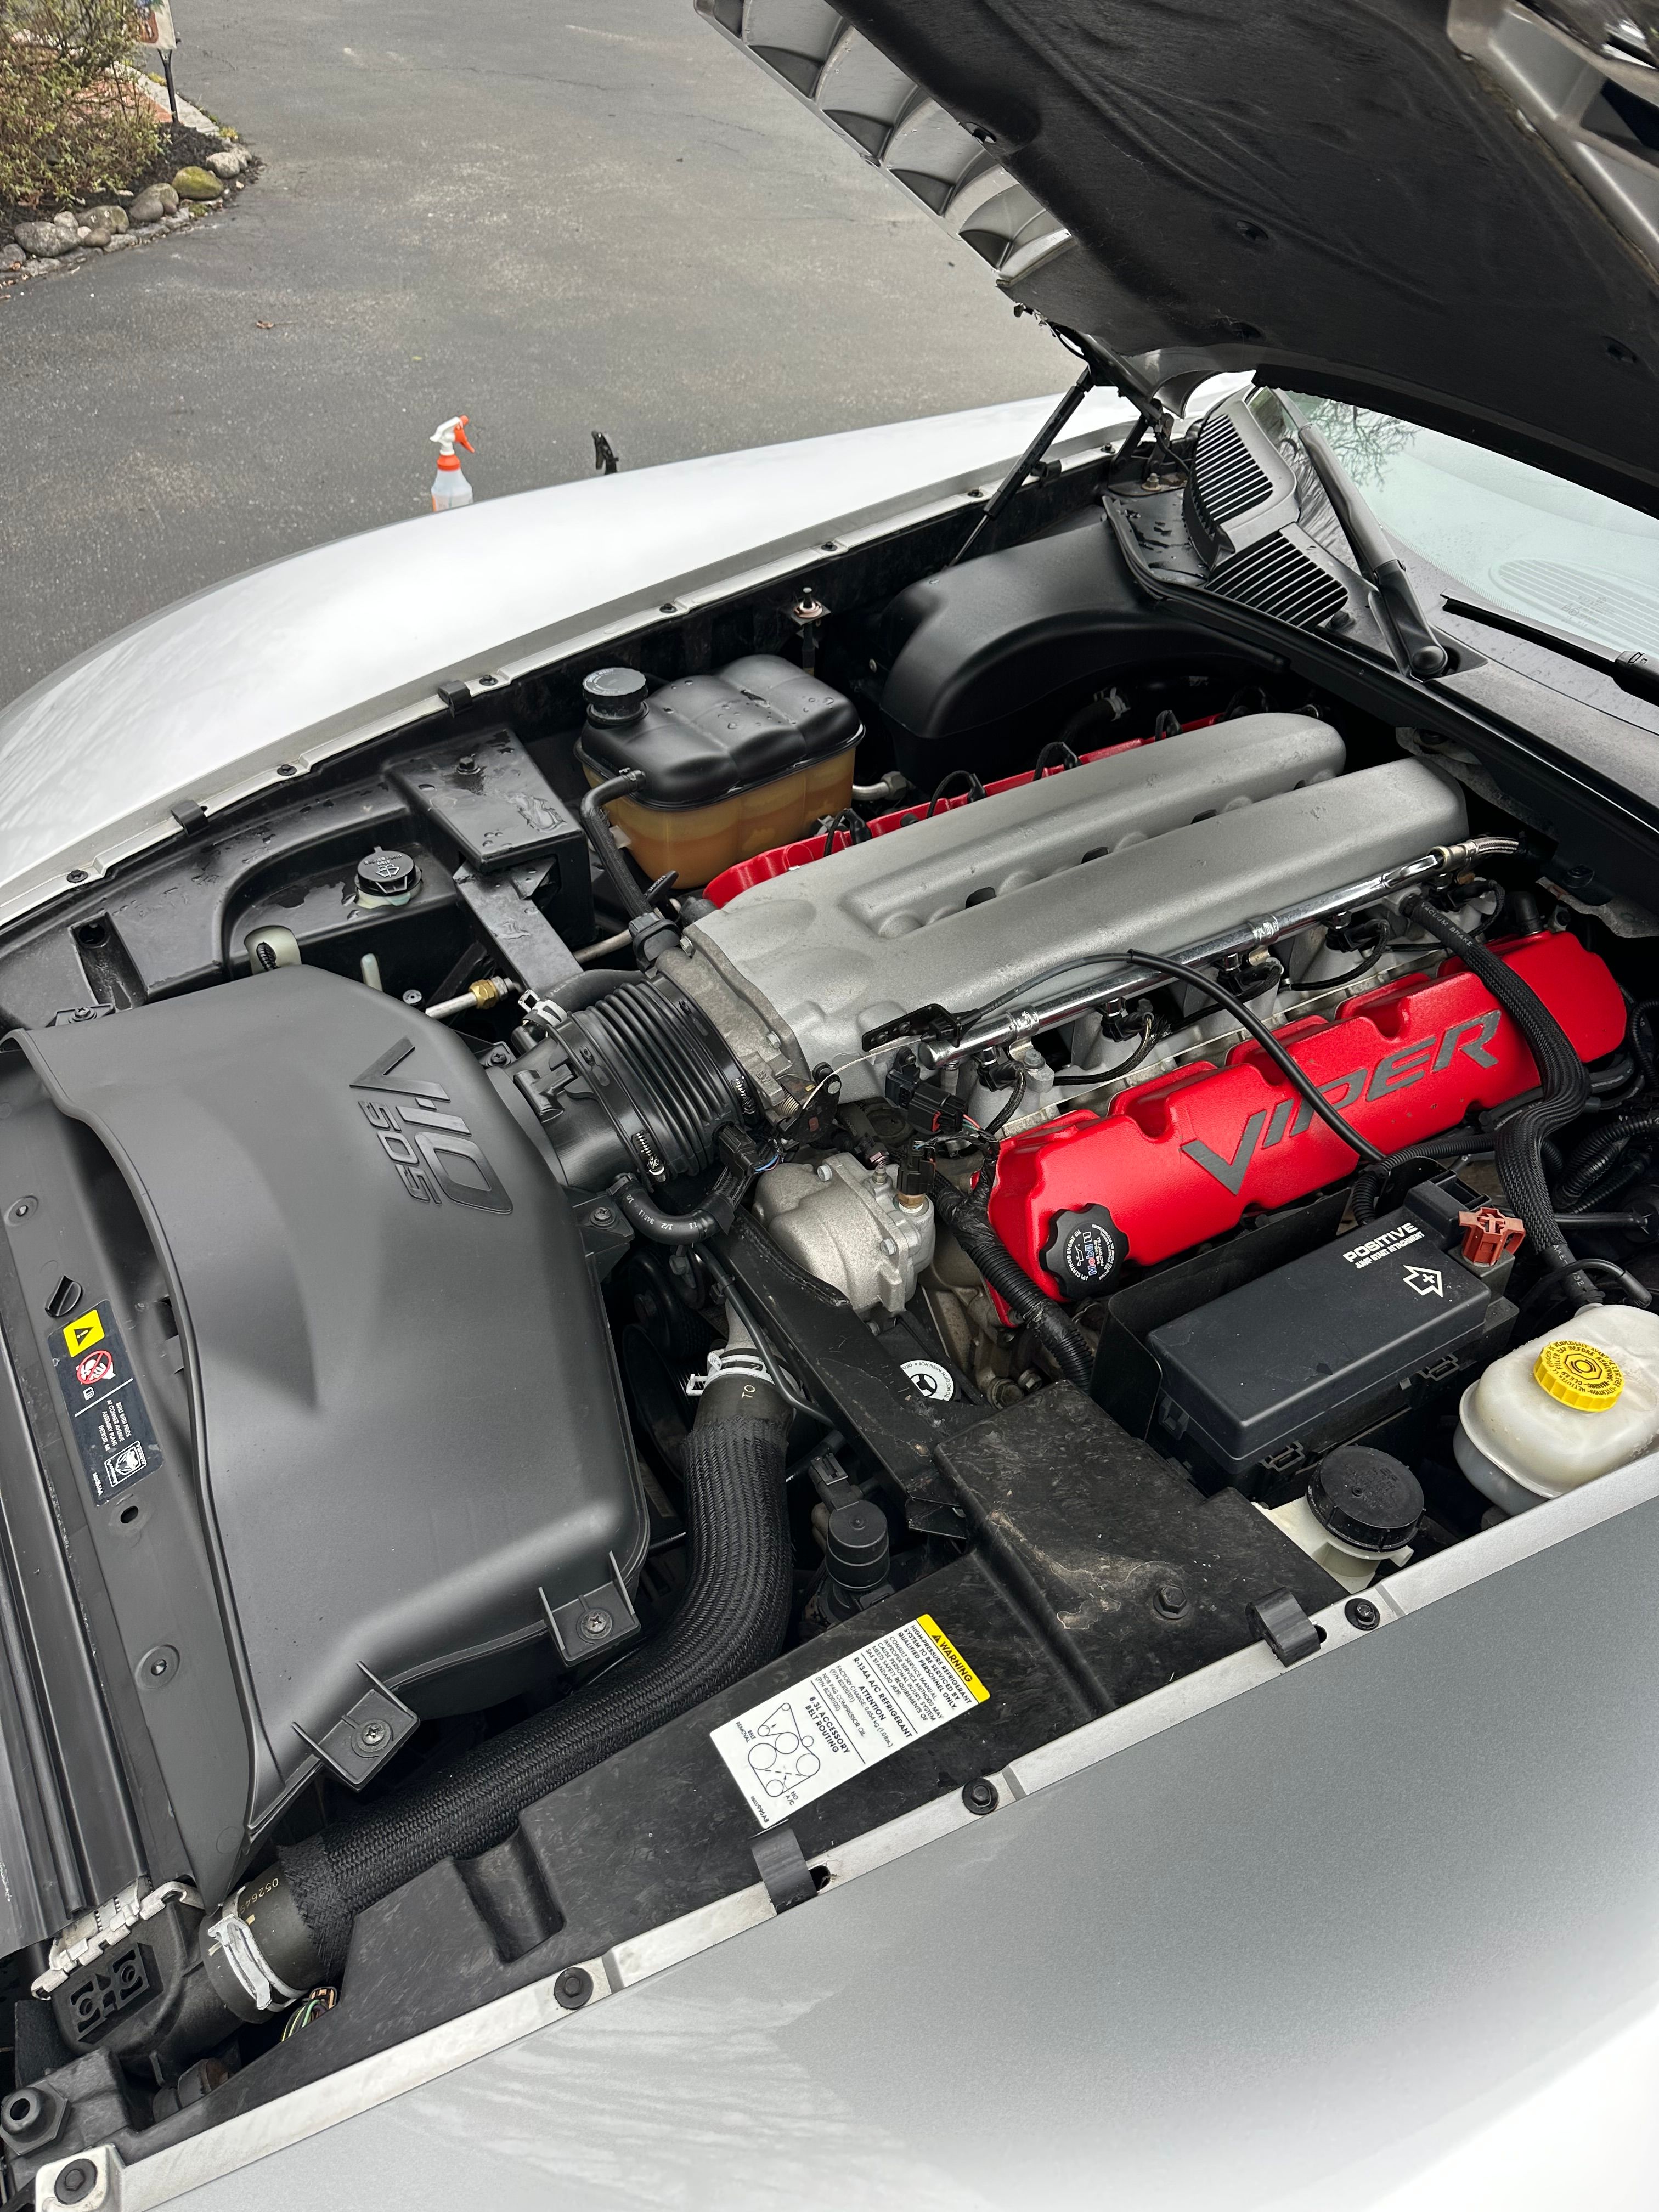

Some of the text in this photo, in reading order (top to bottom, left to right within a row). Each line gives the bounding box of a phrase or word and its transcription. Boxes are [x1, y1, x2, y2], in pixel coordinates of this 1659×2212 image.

[1421, 902, 1473, 947] VACUUM BRAKE
[1181, 1009, 1502, 1195] VIPER
[358, 1101, 442, 1205] 505
[626, 1194, 634, 1204] 1/2
[1066, 1235, 1075, 1254] ENGINE
[1342, 1222, 1418, 1262] POSITIVE
[1355, 1231, 1425, 1269] JUMP START ATTACHMENT
[1066, 1255, 1081, 1278] CERTIFIED
[1085, 1244, 1097, 1276] Mobil
[929, 1364, 942, 1373] WHEN
[1554, 1353, 1563, 1370] FILLER
[1569, 1346, 1594, 1356] BEFORE
[1590, 1348, 1608, 1358] AVANT
[941, 1372, 950, 1383] OPEN
[1561, 1371, 1583, 1385] CLEAN
[1596, 1357, 1614, 1381] REMOVING
[102, 1411, 118, 1446] ASSEMBLY PLANT
[114, 1424, 125, 1442] AVENUE
[115, 1402, 124, 1414] BUILT
[123, 1424, 132, 1437] PRIDE
[830, 1668, 840, 1680] (P/N
[866, 1649, 875, 1659] SAE
[872, 1658, 893, 1684] STANDARD
[889, 1636, 907, 1657] CONSULT
[905, 1657, 922, 1677] SERVICE
[898, 1632, 957, 1710] QUALIFIED PERSONNEL ONLY.
[904, 1628, 922, 1649] SYSTEM
[919, 1647, 927, 1656] TO
[931, 1664, 953, 1691] SERVICED
[951, 1692, 961, 1700] BY
[910, 1625, 972, 1703] HIGH-PRESSURE REFRIGERANT
[940, 1642, 972, 1682] WARNING
[815, 1677, 826, 1688] (P/N
[836, 1665, 853, 1685] FACTORY
[873, 1719, 880, 1728] kg
[872, 1645, 885, 1661] MEETS
[882, 1660, 897, 1677] SAFETY
[894, 1677, 922, 1713] REQUIREMENTS
[878, 1643, 891, 1658] CAUSE
[889, 1658, 909, 1684] PERSONAL
[920, 1701, 936, 1721] SYSTEM
[883, 1639, 944, 1719] IMPROPER SERVICE METHODS MAY
[828, 1683, 838, 1694] PAG
[836, 1694, 860, 1728] COMPRESSOR
[853, 1657, 912, 1737] R-134A A/C REFRIGERANT
[858, 1686, 886, 1720] ATTENTION
[736, 1721, 751, 1743] REMOVAL
[747, 1729, 757, 1740] BELT
[805, 1705, 839, 1753] BELT ROUTING
[809, 1696, 850, 1753] 8.3L ACCESSORY
[785, 1795, 795, 1806] A/C
[790, 1791, 798, 1800] NO
